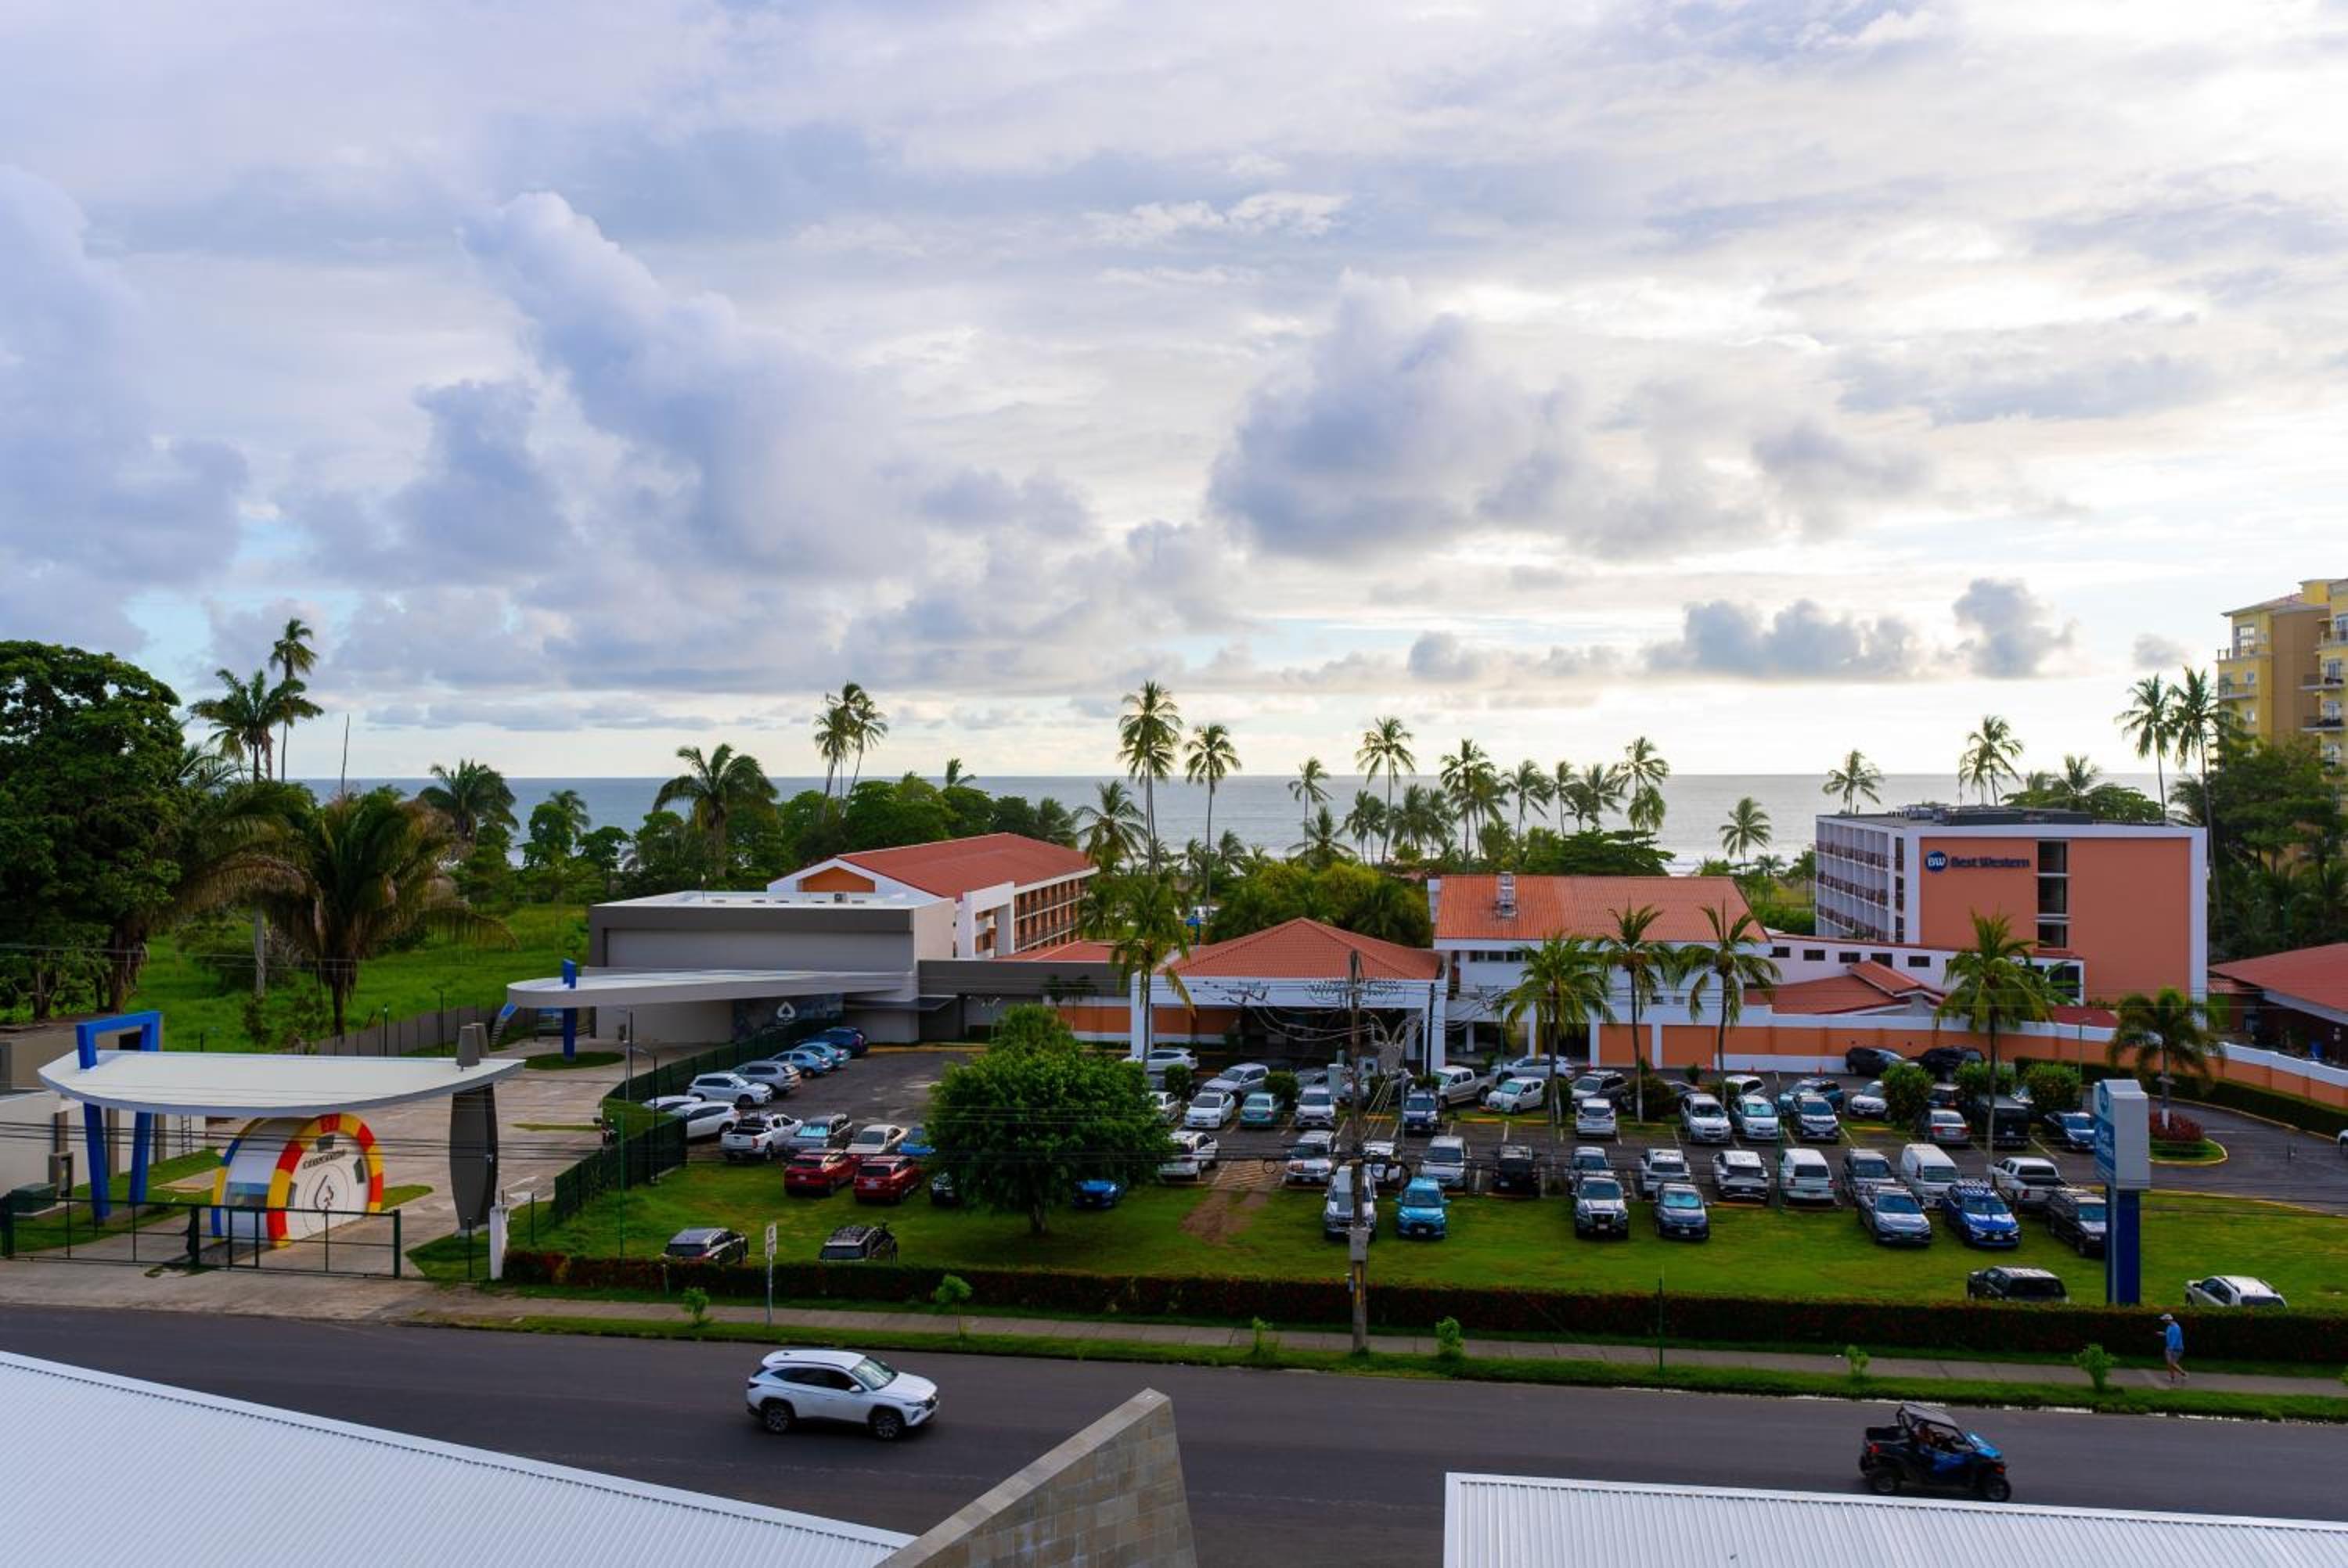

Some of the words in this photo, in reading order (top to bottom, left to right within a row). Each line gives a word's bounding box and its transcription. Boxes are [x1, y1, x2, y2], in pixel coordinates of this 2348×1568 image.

[1928, 857, 1946, 866] BW
[1951, 857, 1976, 868] Best
[1979, 857, 2029, 868] Western
